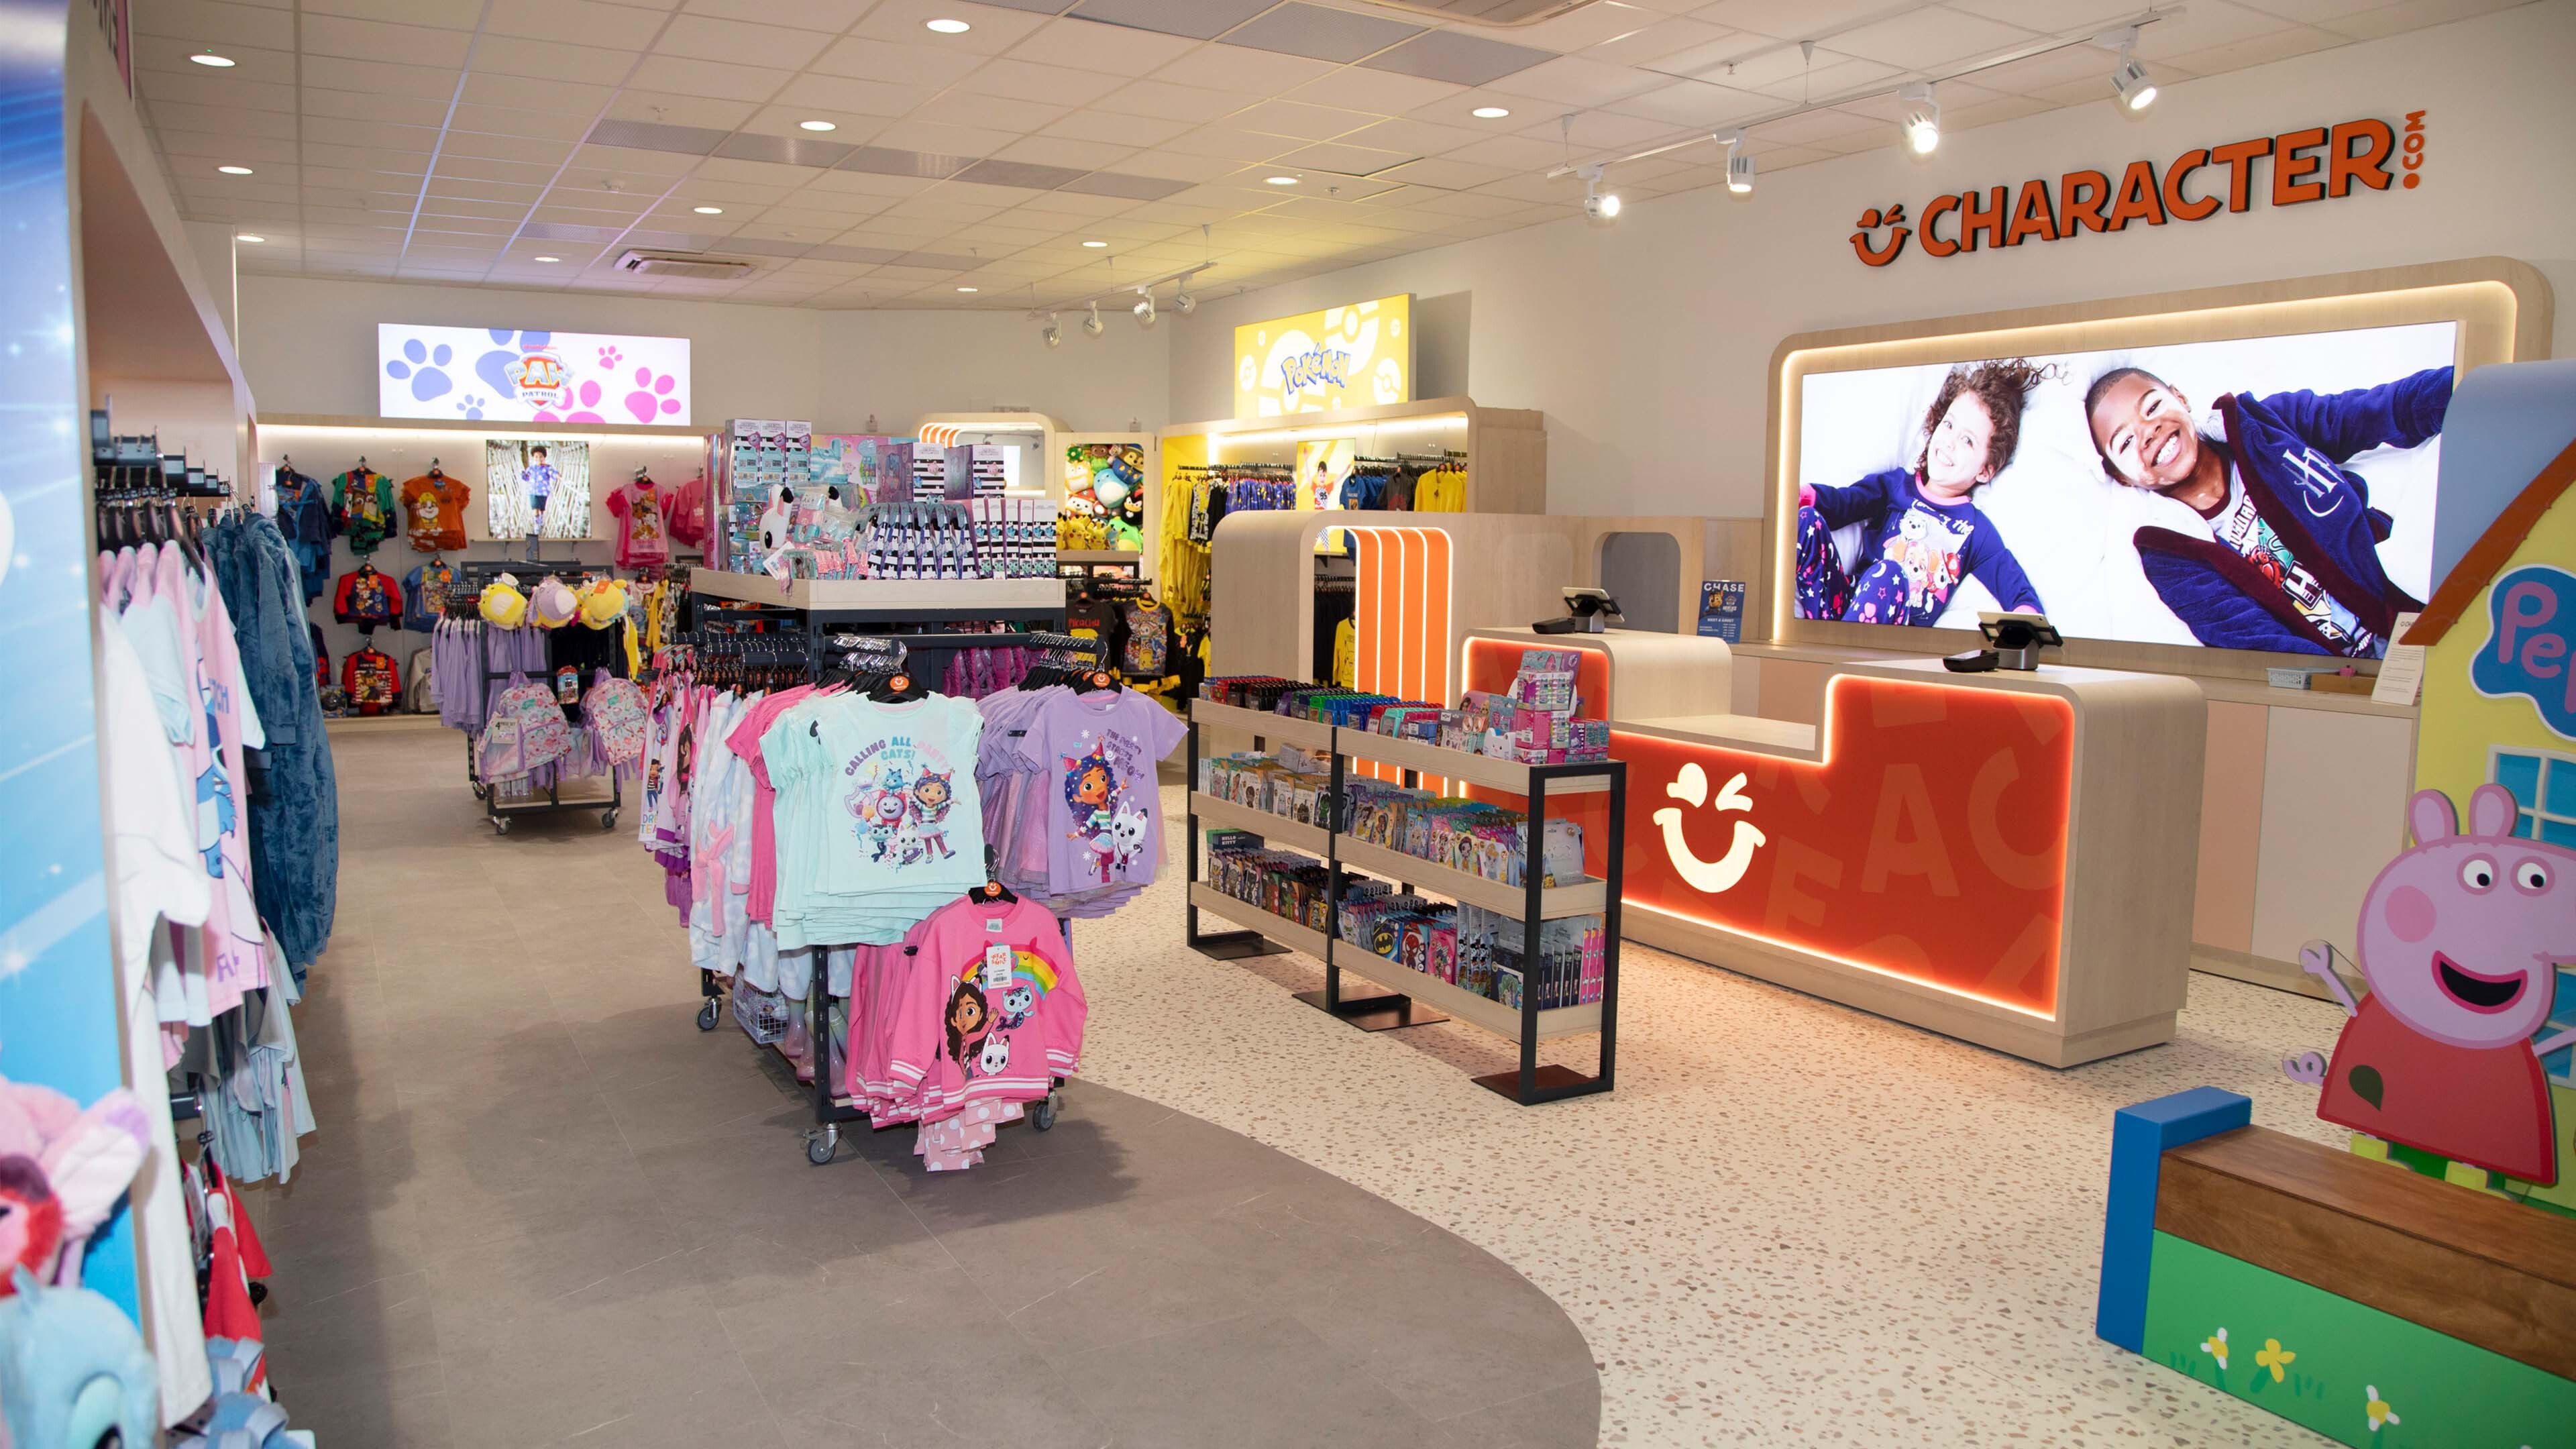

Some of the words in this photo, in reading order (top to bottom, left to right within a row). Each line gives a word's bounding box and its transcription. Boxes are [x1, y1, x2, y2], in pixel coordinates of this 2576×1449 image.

[1919, 118, 2396, 257] CHARACTER
[504, 360, 574, 388] PAW
[1703, 582, 1745, 592] CHASE
[2497, 581, 2576, 714] Pe
[845, 739, 886, 775] CALLING
[892, 737, 911, 747] ALL
[881, 749, 915, 760] CATS!
